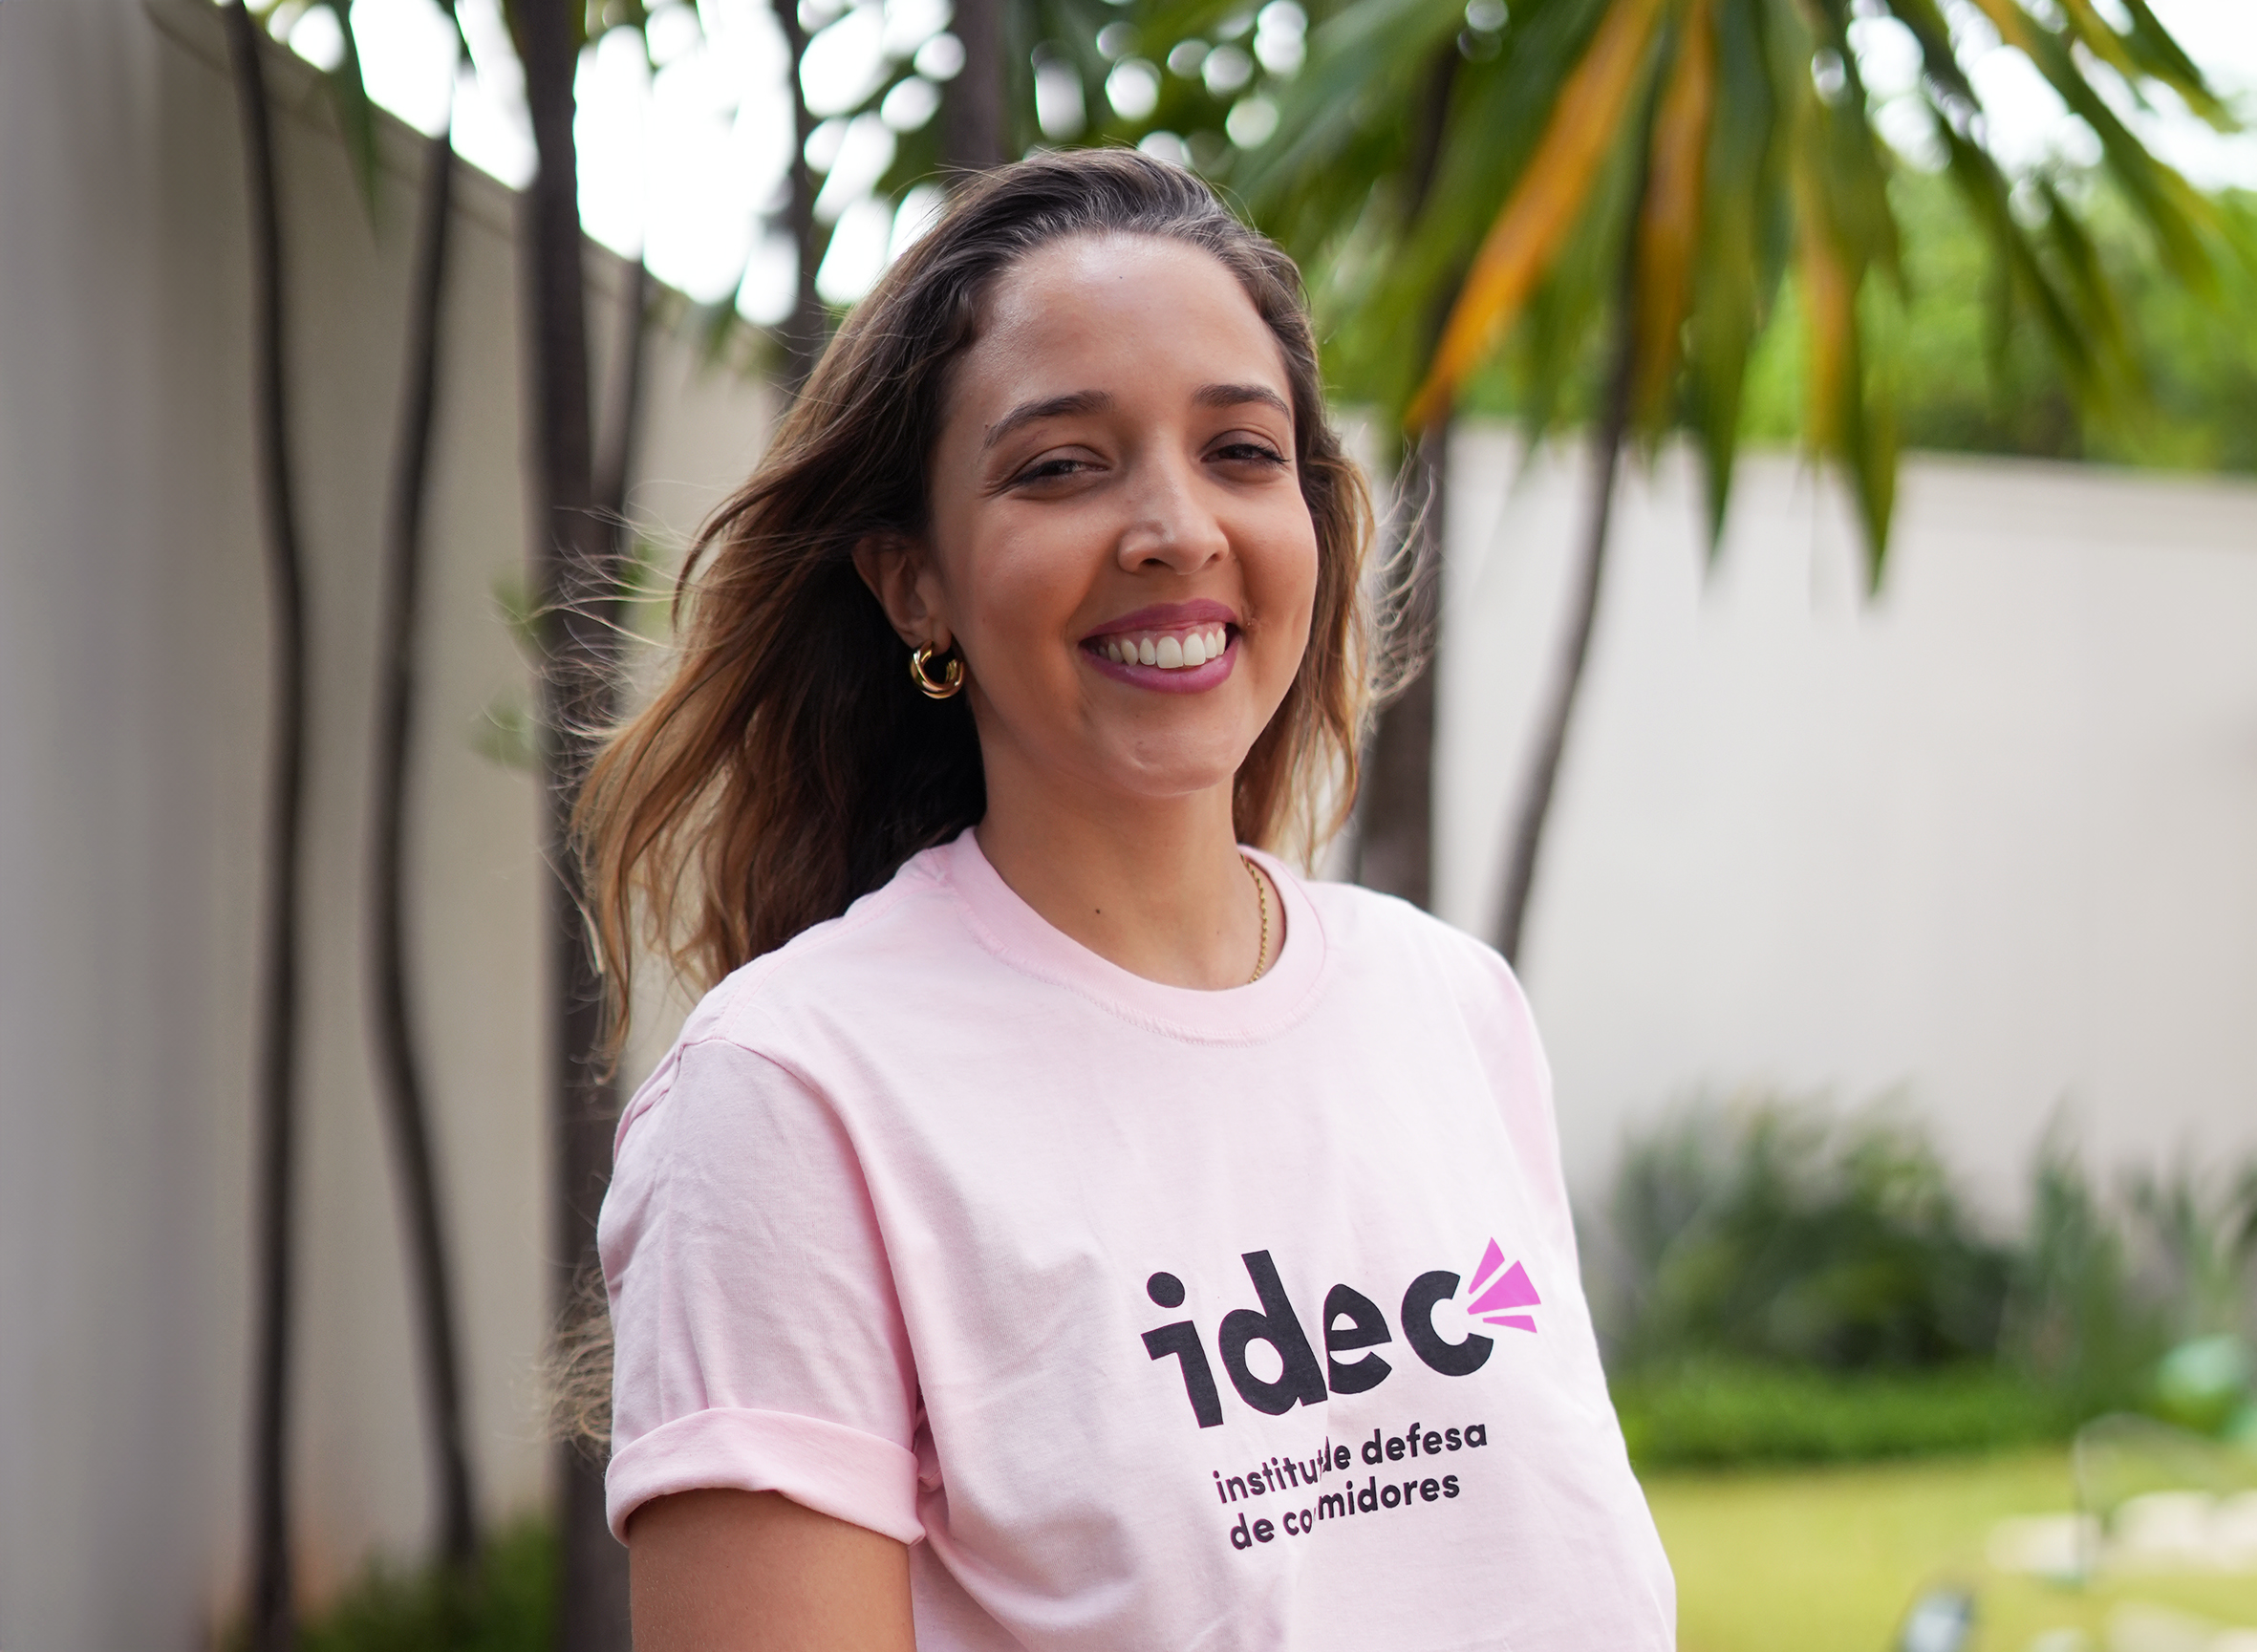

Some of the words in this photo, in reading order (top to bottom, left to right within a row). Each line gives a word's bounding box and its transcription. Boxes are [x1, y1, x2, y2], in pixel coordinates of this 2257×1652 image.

[1141, 1250, 1494, 1428] idec
[1362, 1422, 1488, 1466] defesa
[1230, 1512, 1275, 1551] de
